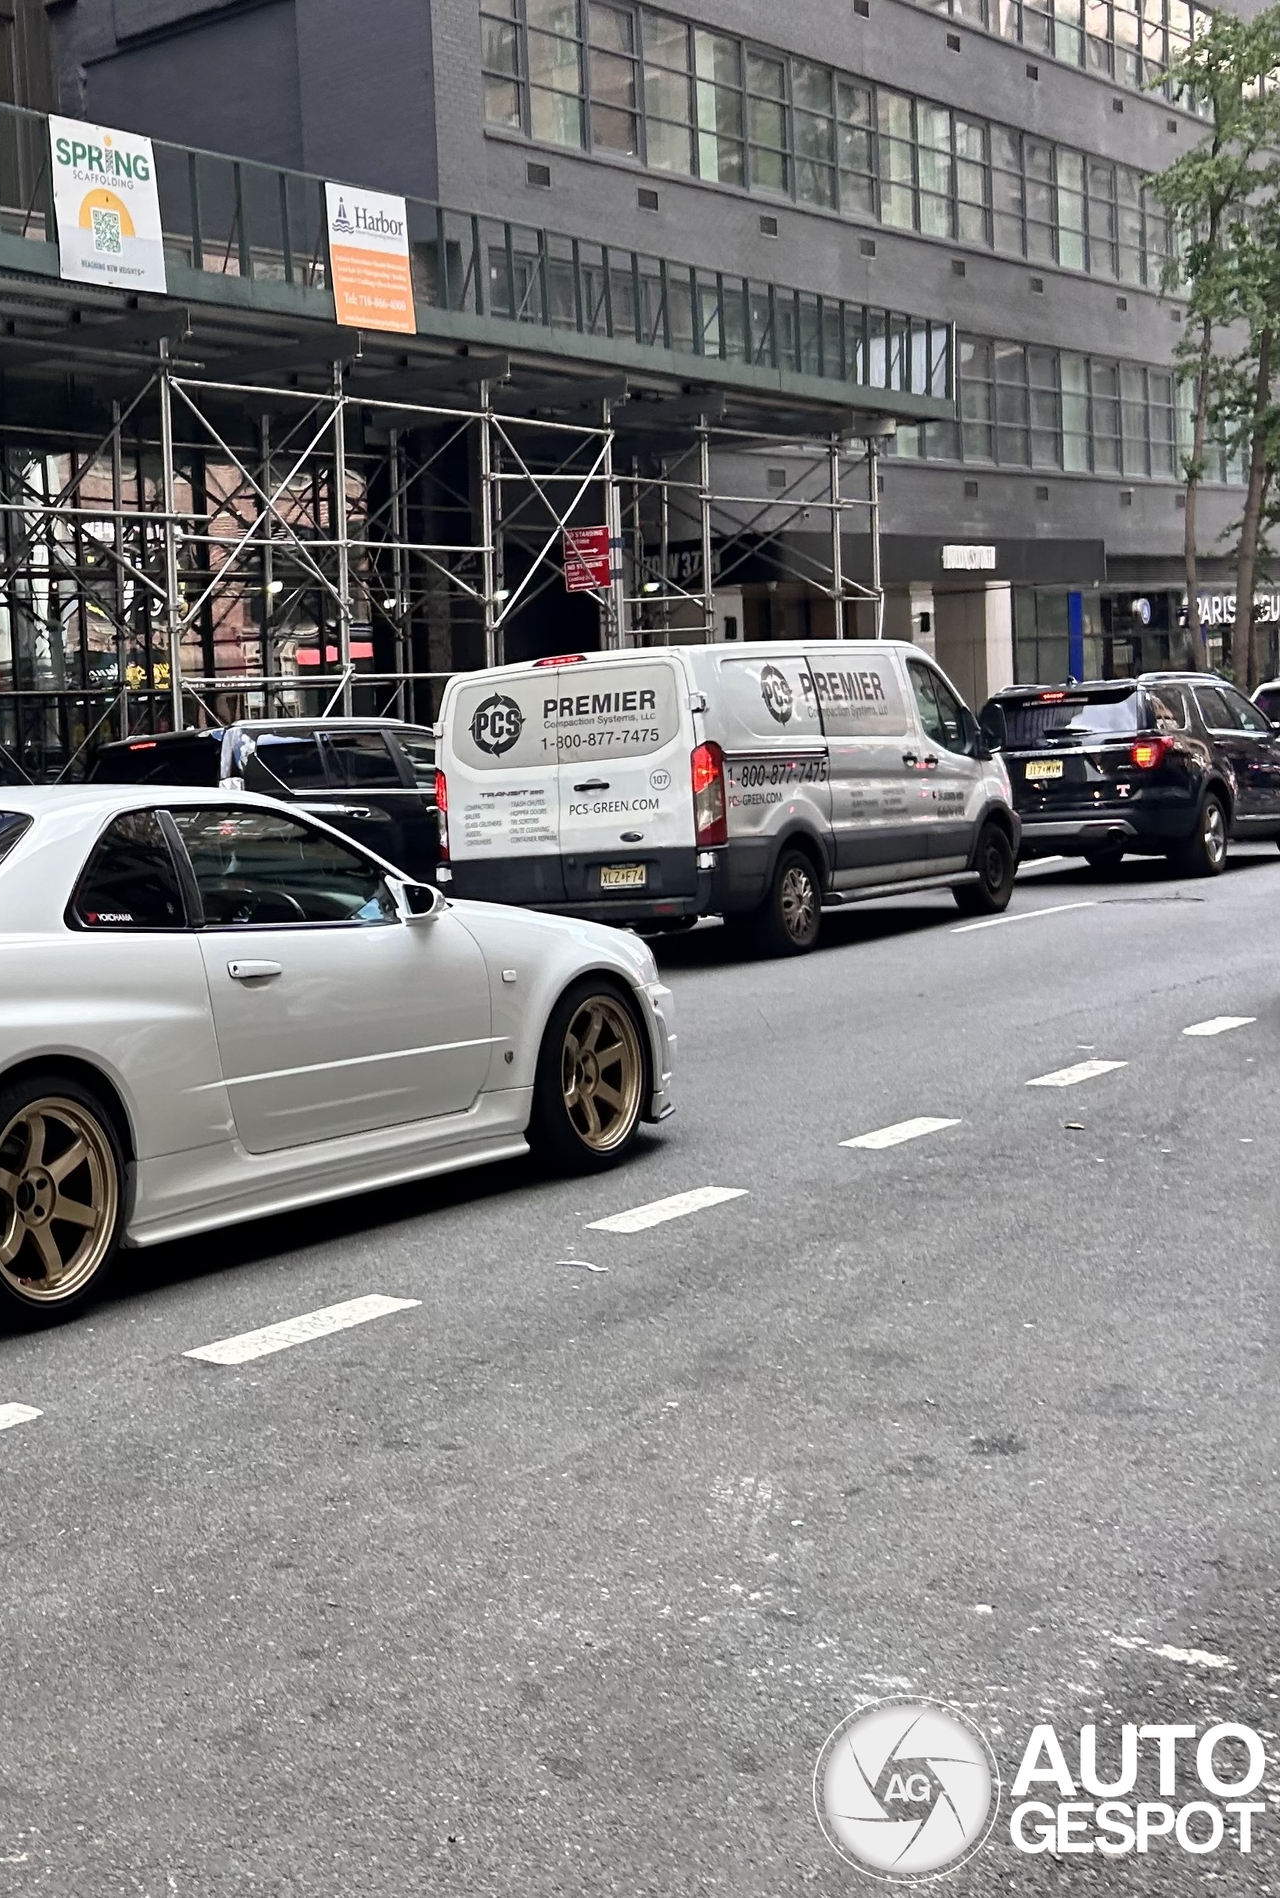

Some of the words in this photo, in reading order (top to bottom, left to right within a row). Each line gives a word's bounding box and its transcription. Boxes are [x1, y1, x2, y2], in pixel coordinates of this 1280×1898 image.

[56, 134, 150, 181] SPRING
[72, 168, 134, 190] SCAFFOLDING
[354, 206, 404, 236] Harbor
[762, 678, 792, 707] PCS
[798, 671, 885, 702] PREMIER
[543, 689, 656, 719] PREMIER
[475, 709, 521, 741] PCS
[543, 717, 595, 729] Compaction
[597, 712, 639, 725] Systems,
[641, 712, 656, 721] LLC
[541, 728, 660, 750] 1-800-877-7475
[652, 775, 668, 785] 107
[727, 761, 828, 788] 1-800-877-7475
[479, 790, 528, 798] TRANSIT
[569, 798, 659, 816] PCS-GREEN.COM
[97, 913, 134, 922] YOKOHAMA
